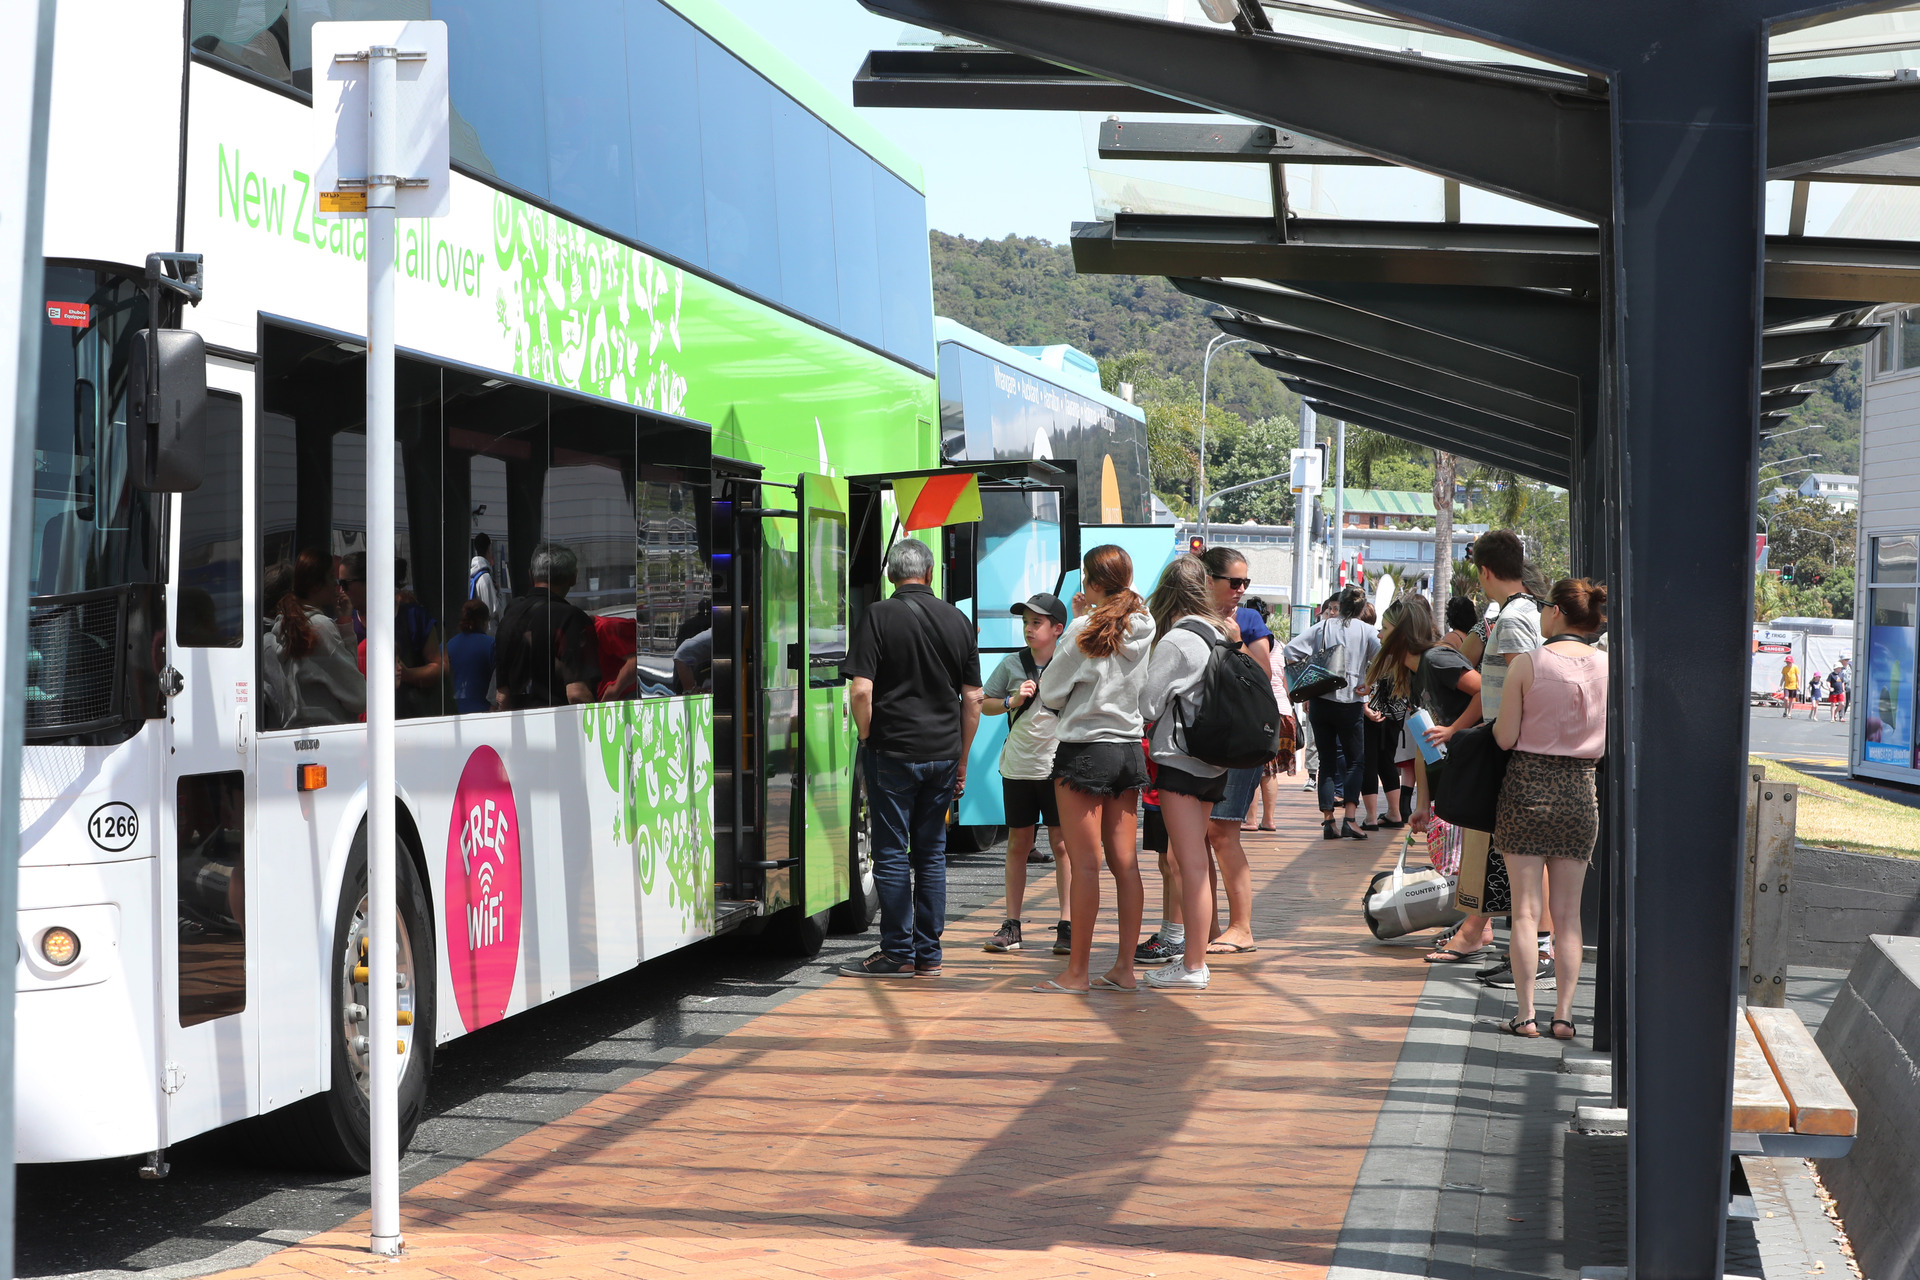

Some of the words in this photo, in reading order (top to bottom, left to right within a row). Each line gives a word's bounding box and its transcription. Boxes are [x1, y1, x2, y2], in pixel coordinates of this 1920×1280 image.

[218, 142, 286, 236] New
[405, 216, 432, 283] all
[436, 239, 485, 299] over
[994, 365, 1017, 399] Whangarei
[1021, 376, 1040, 405] Auckland
[92, 815, 137, 838] 1266
[460, 799, 509, 876] FREE
[1405, 886, 1436, 897] COUNTRY
[1437, 881, 1455, 890] ROAD
[466, 890, 504, 951] WiFi
